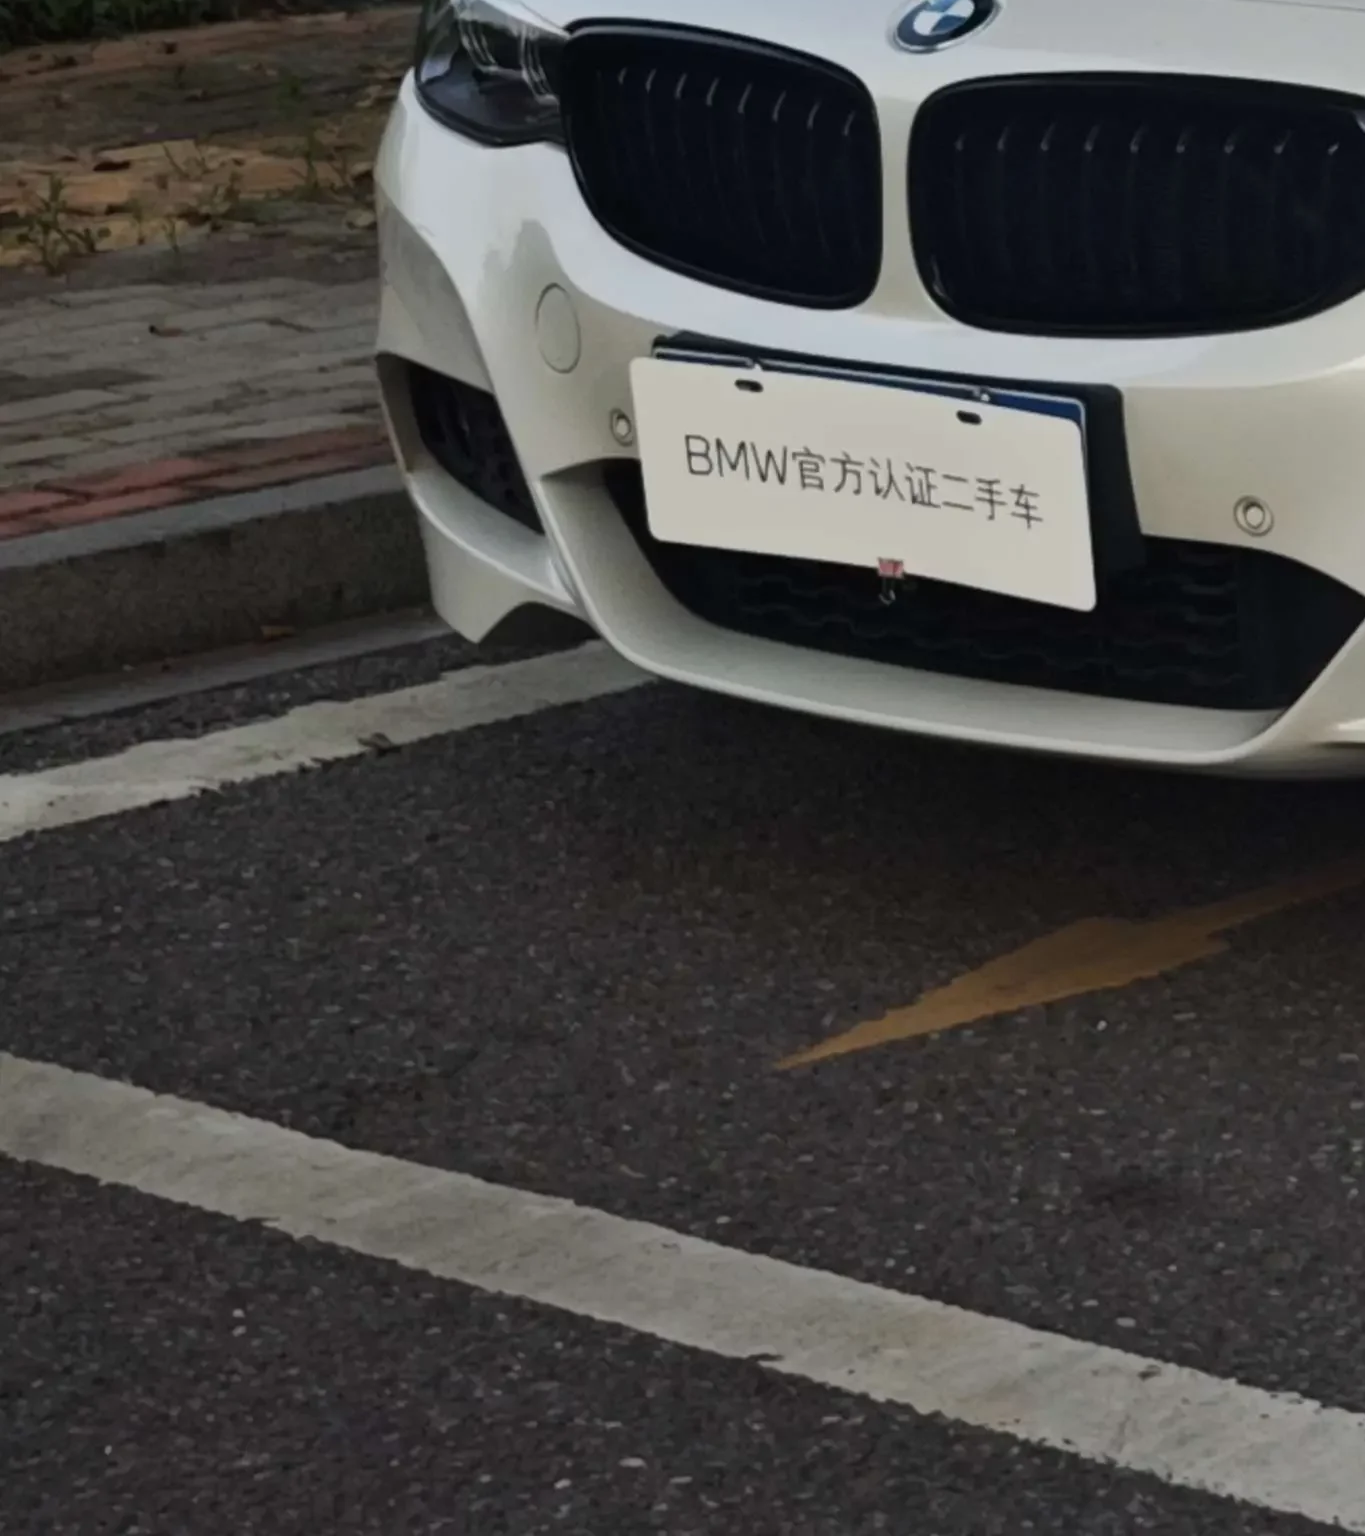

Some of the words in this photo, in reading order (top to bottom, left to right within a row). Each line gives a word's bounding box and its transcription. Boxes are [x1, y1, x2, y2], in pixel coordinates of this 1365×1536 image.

[685, 434, 1043, 528] BMW官方认证二手车
